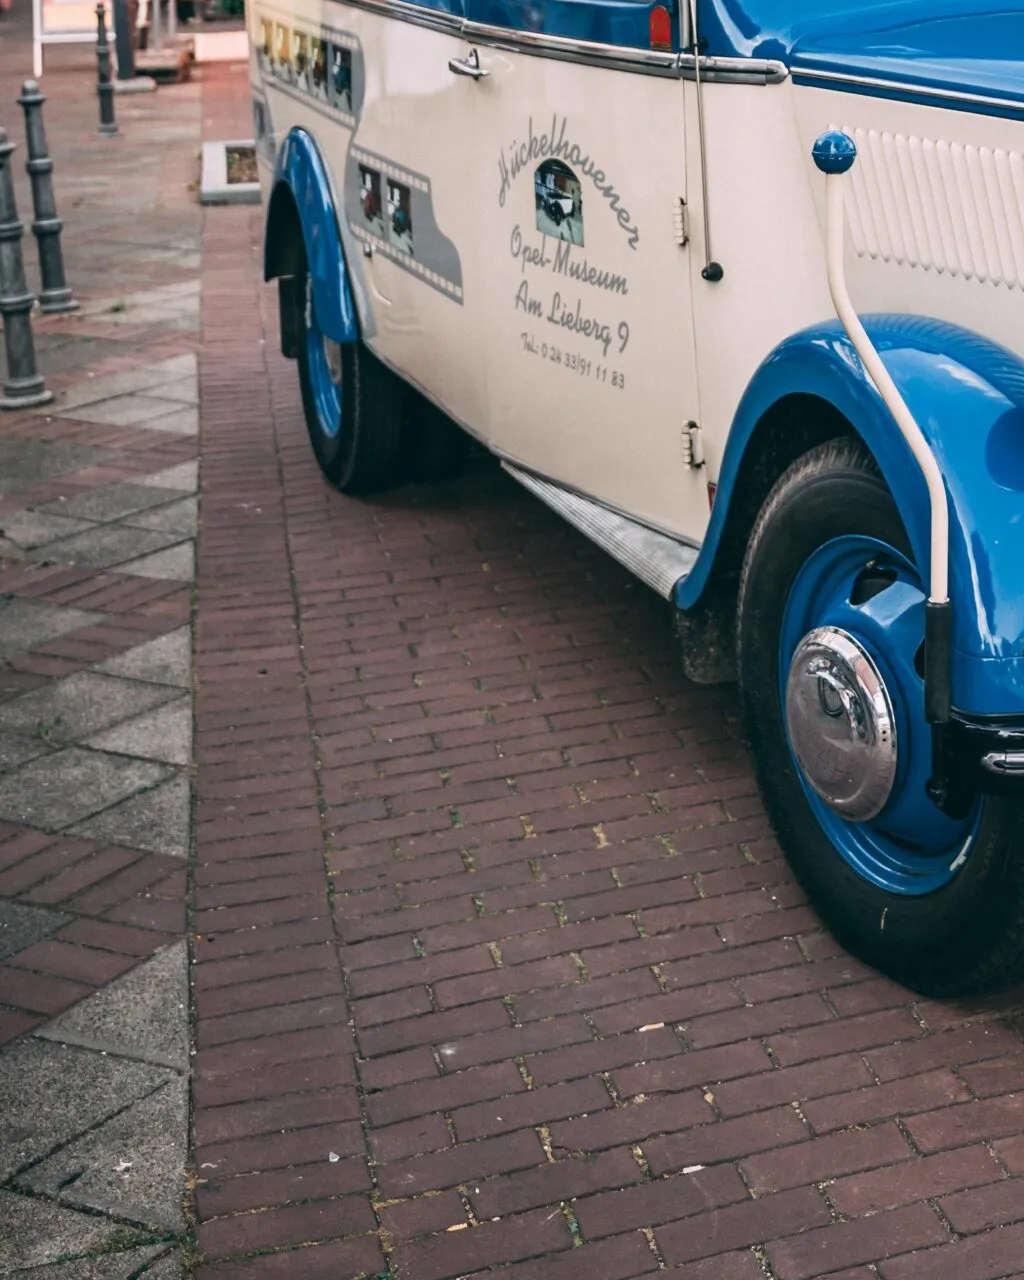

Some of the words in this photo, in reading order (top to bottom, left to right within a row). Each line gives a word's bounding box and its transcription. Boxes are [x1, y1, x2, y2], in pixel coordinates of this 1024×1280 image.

[499, 113, 640, 250] Hückelhovener
[515, 279, 543, 318] Am
[547, 291, 612, 357] Lieberg
[618, 321, 630, 354] 9
